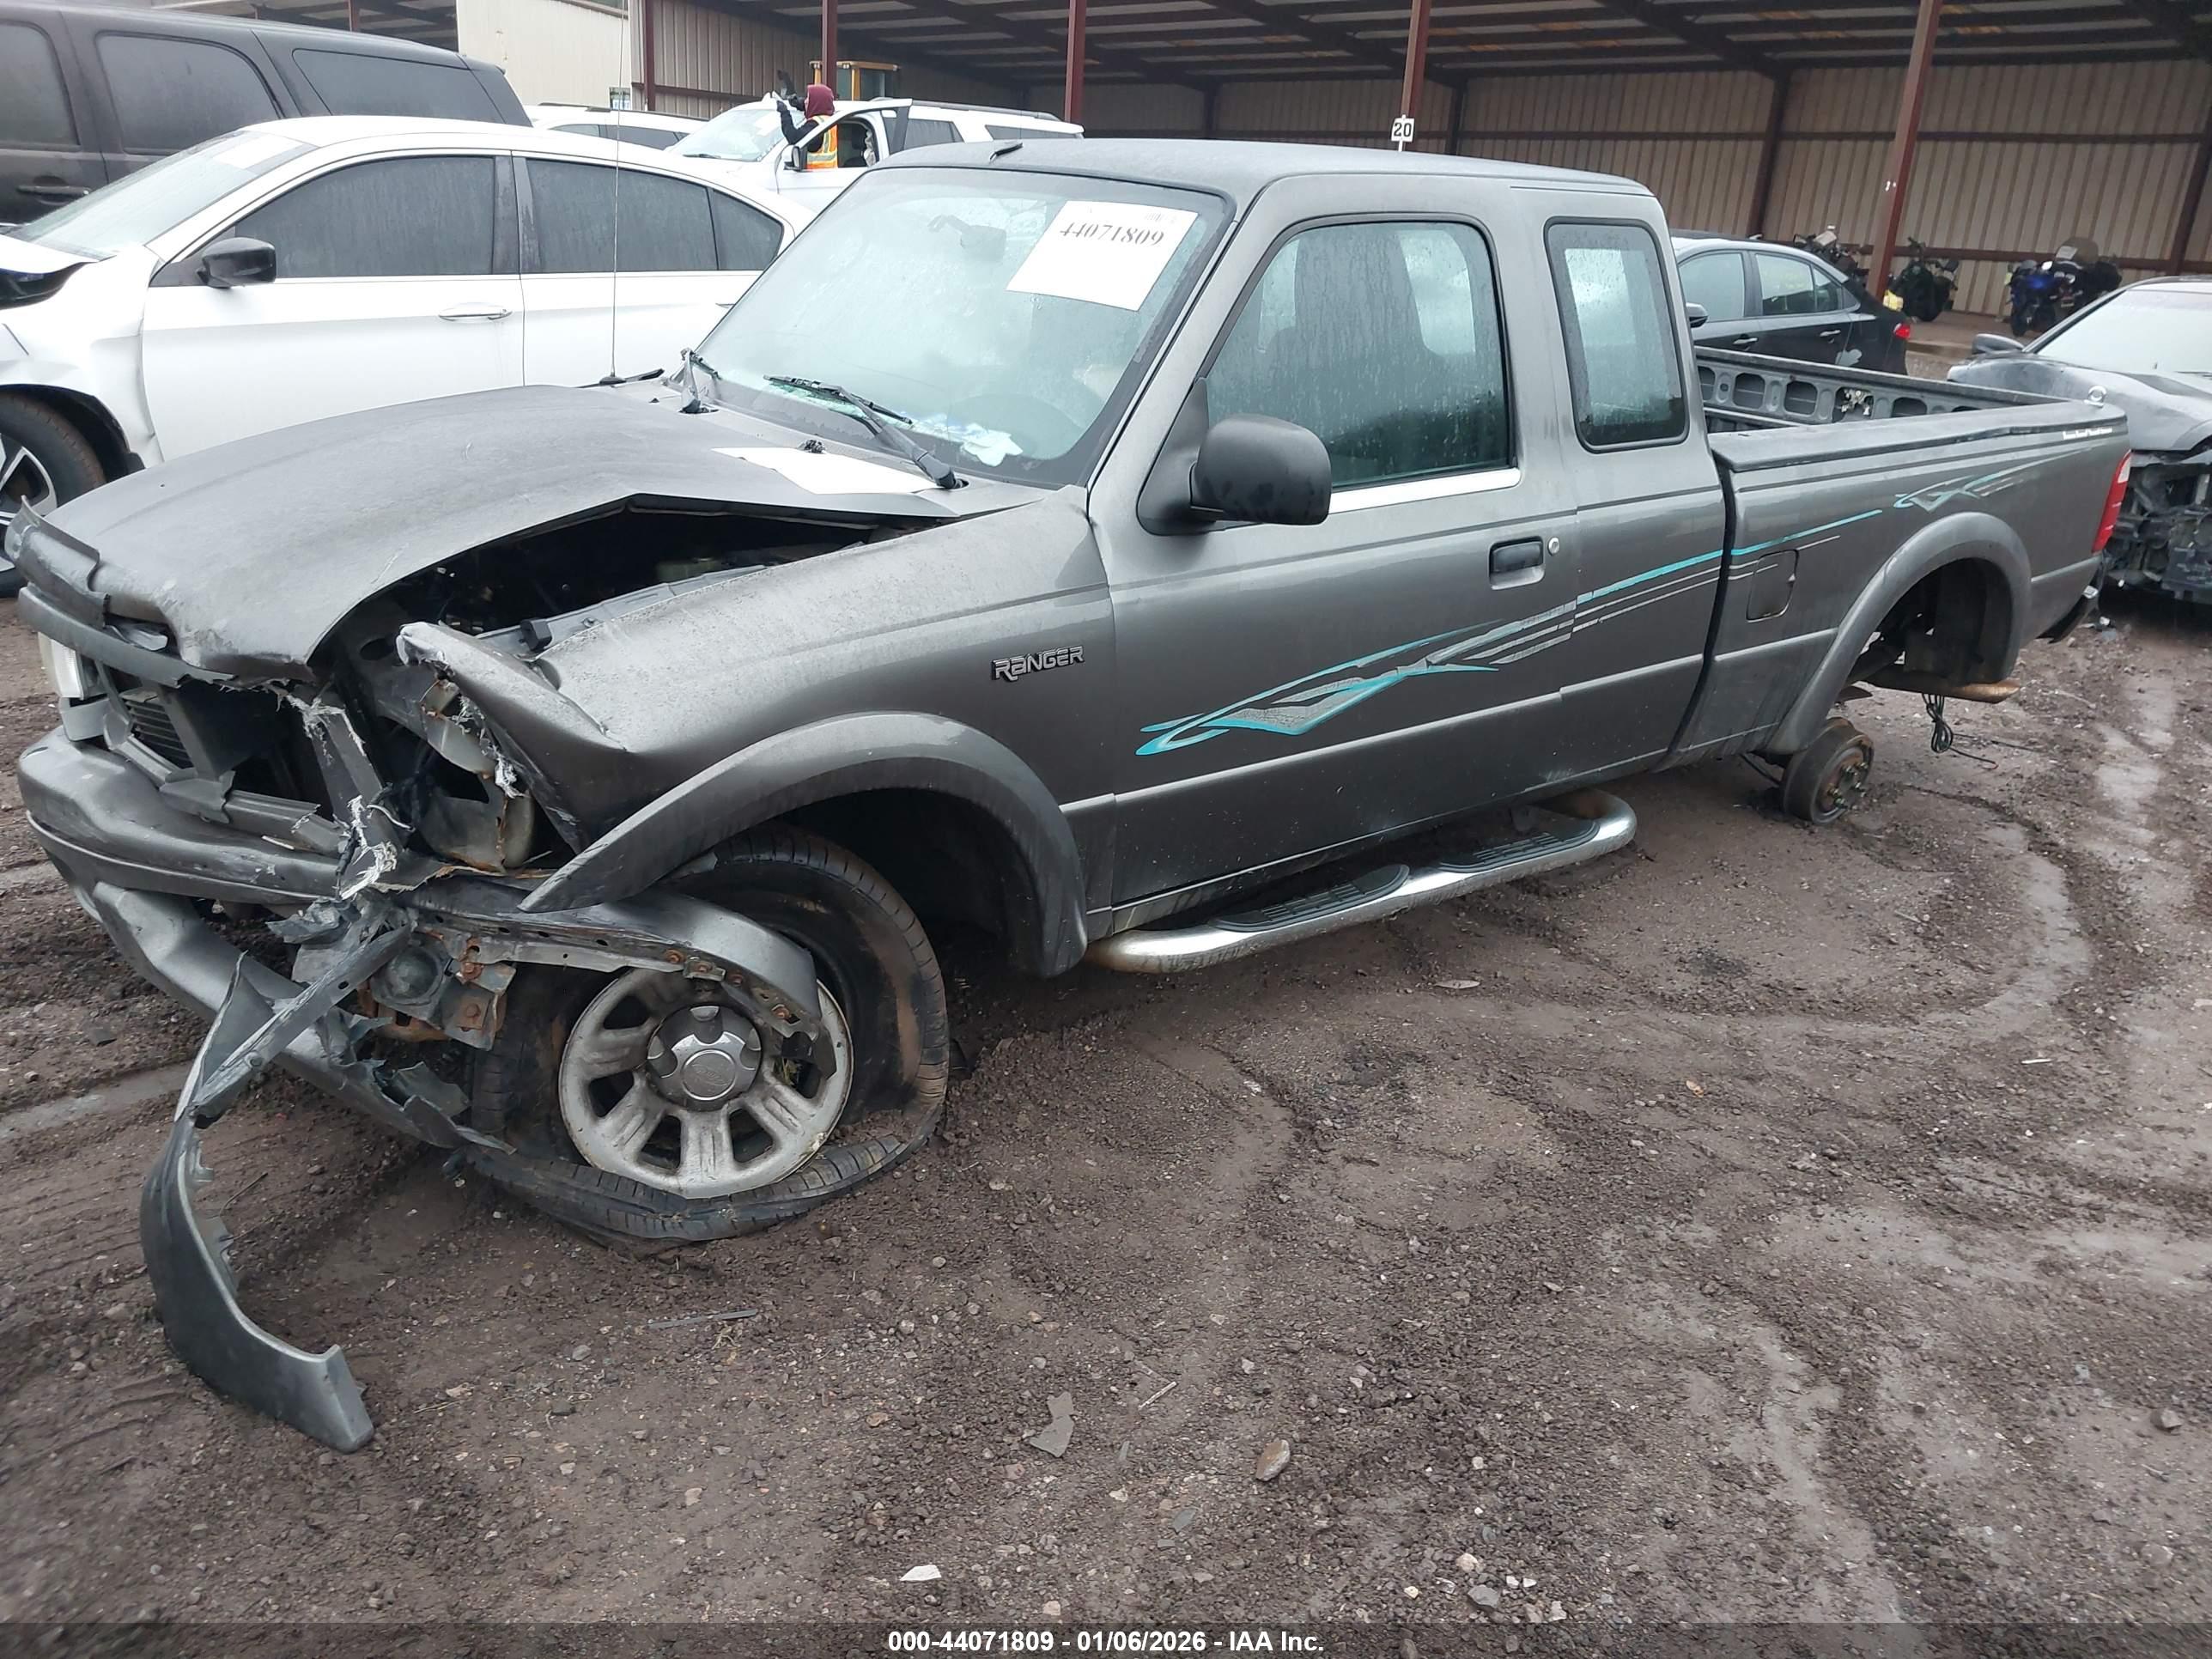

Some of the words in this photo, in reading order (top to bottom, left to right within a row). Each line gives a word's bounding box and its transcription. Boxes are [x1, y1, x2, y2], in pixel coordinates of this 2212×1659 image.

[1394, 122, 1413, 137] 20
[1059, 222, 1165, 246] 44071809
[992, 646, 1085, 682] RANGER
